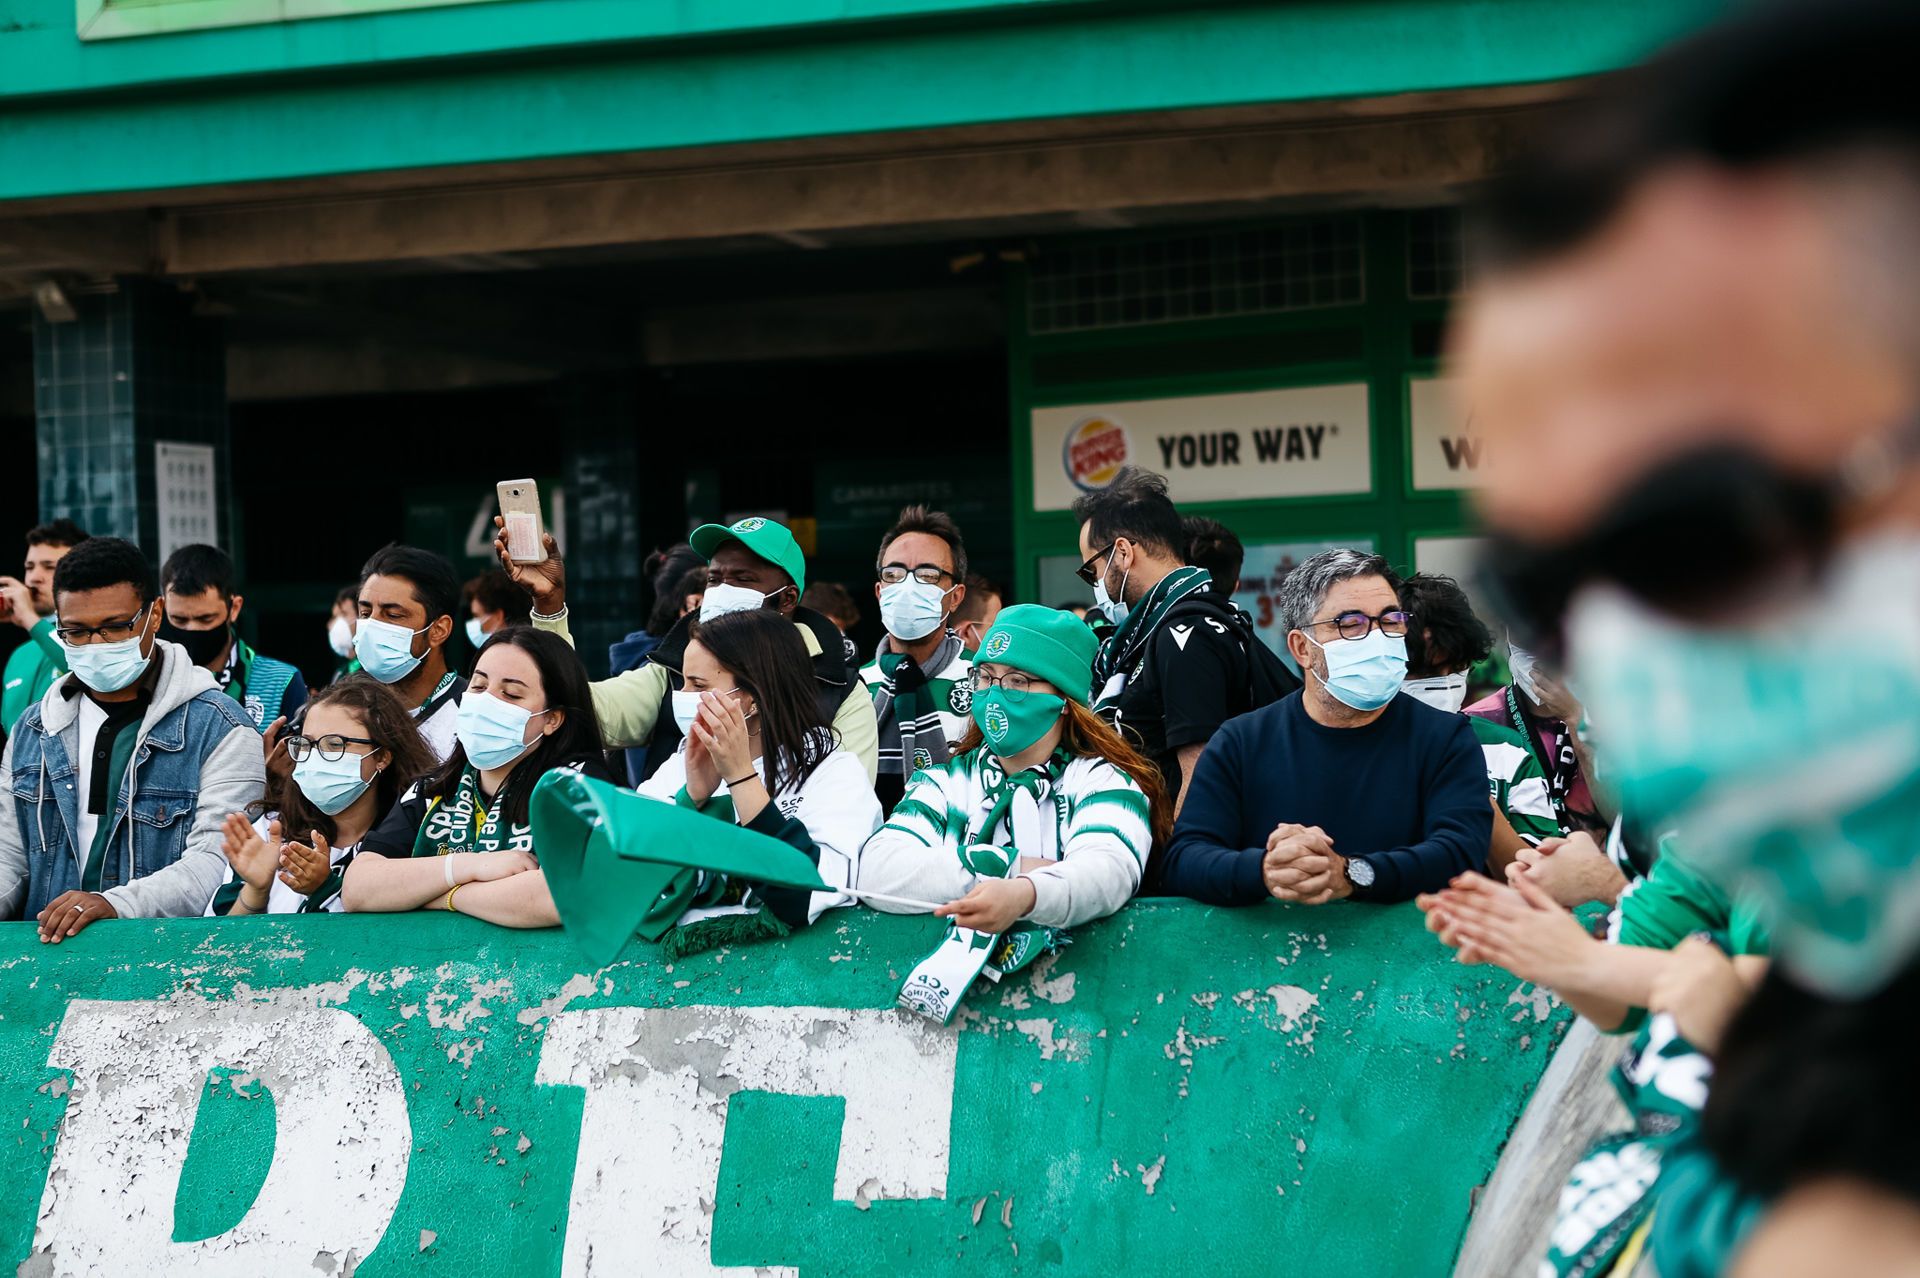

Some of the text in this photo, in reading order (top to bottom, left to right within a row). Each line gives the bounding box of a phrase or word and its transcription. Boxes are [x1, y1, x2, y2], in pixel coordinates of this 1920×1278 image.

[1072, 446, 1127, 481] KING
[1157, 430, 1240, 469] YOUR
[1439, 437, 1485, 470] W
